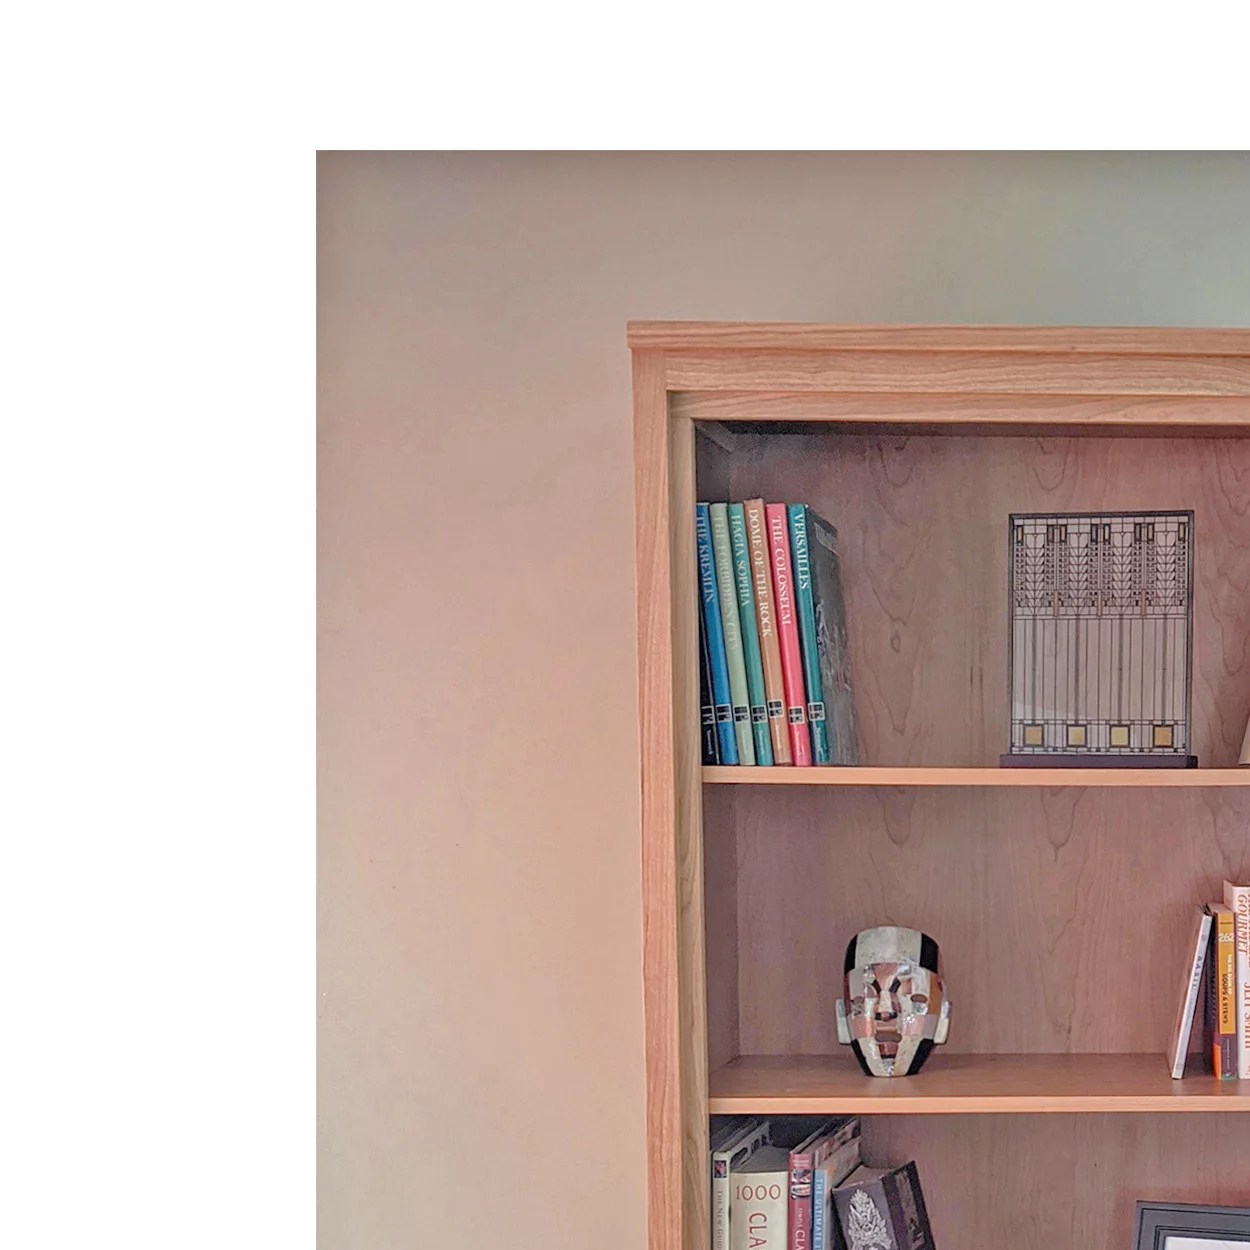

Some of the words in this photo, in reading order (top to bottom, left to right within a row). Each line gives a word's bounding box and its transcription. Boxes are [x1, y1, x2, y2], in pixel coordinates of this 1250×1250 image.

[731, 515, 745, 561] HAGIA
[748, 509, 763, 549] DOME
[771, 516, 784, 545] THE
[754, 550, 765, 568] OF
[793, 513, 810, 590] VERSAILLES
[699, 545, 716, 604] KREMLIN
[736, 560, 750, 607] SOPHIA
[755, 570, 767, 601] THE
[774, 548, 791, 625] COLOSSEUM
[759, 602, 772, 638] ROCK
[1237, 894, 1248, 955] GOURMET
[736, 1184, 781, 1200] 1000
[815, 1179, 823, 1194] THE
[814, 1198, 823, 1241] ULTIMATE
